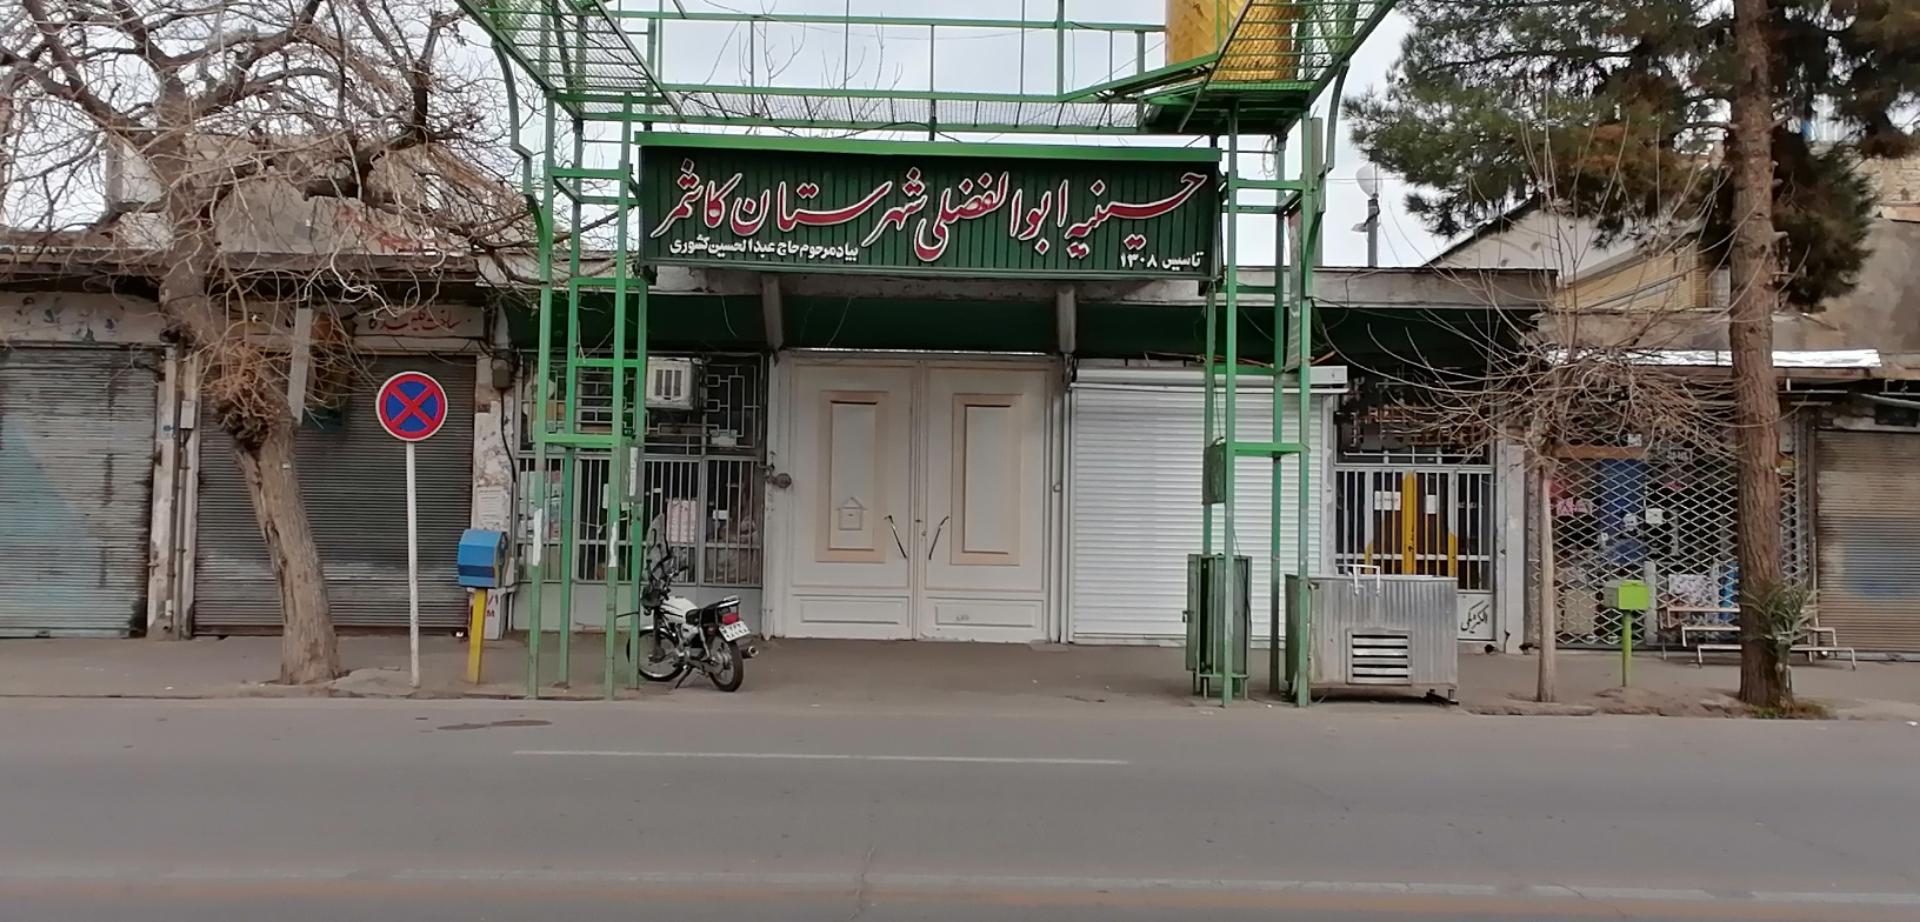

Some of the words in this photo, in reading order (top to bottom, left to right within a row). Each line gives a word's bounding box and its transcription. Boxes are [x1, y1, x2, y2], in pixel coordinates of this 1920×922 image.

[650, 158, 743, 239] کاشمر
[730, 167, 928, 247] شهرستان
[914, 171, 1068, 261] ابوالفضلی
[1065, 172, 1207, 258] حسینیه
[669, 233, 710, 254] کشوری
[777, 240, 800, 256] حاج
[800, 243, 836, 259] مرحوم
[1120, 252, 1158, 268] ۱۳۰۸
[1162, 251, 1204, 271] تاسیس
